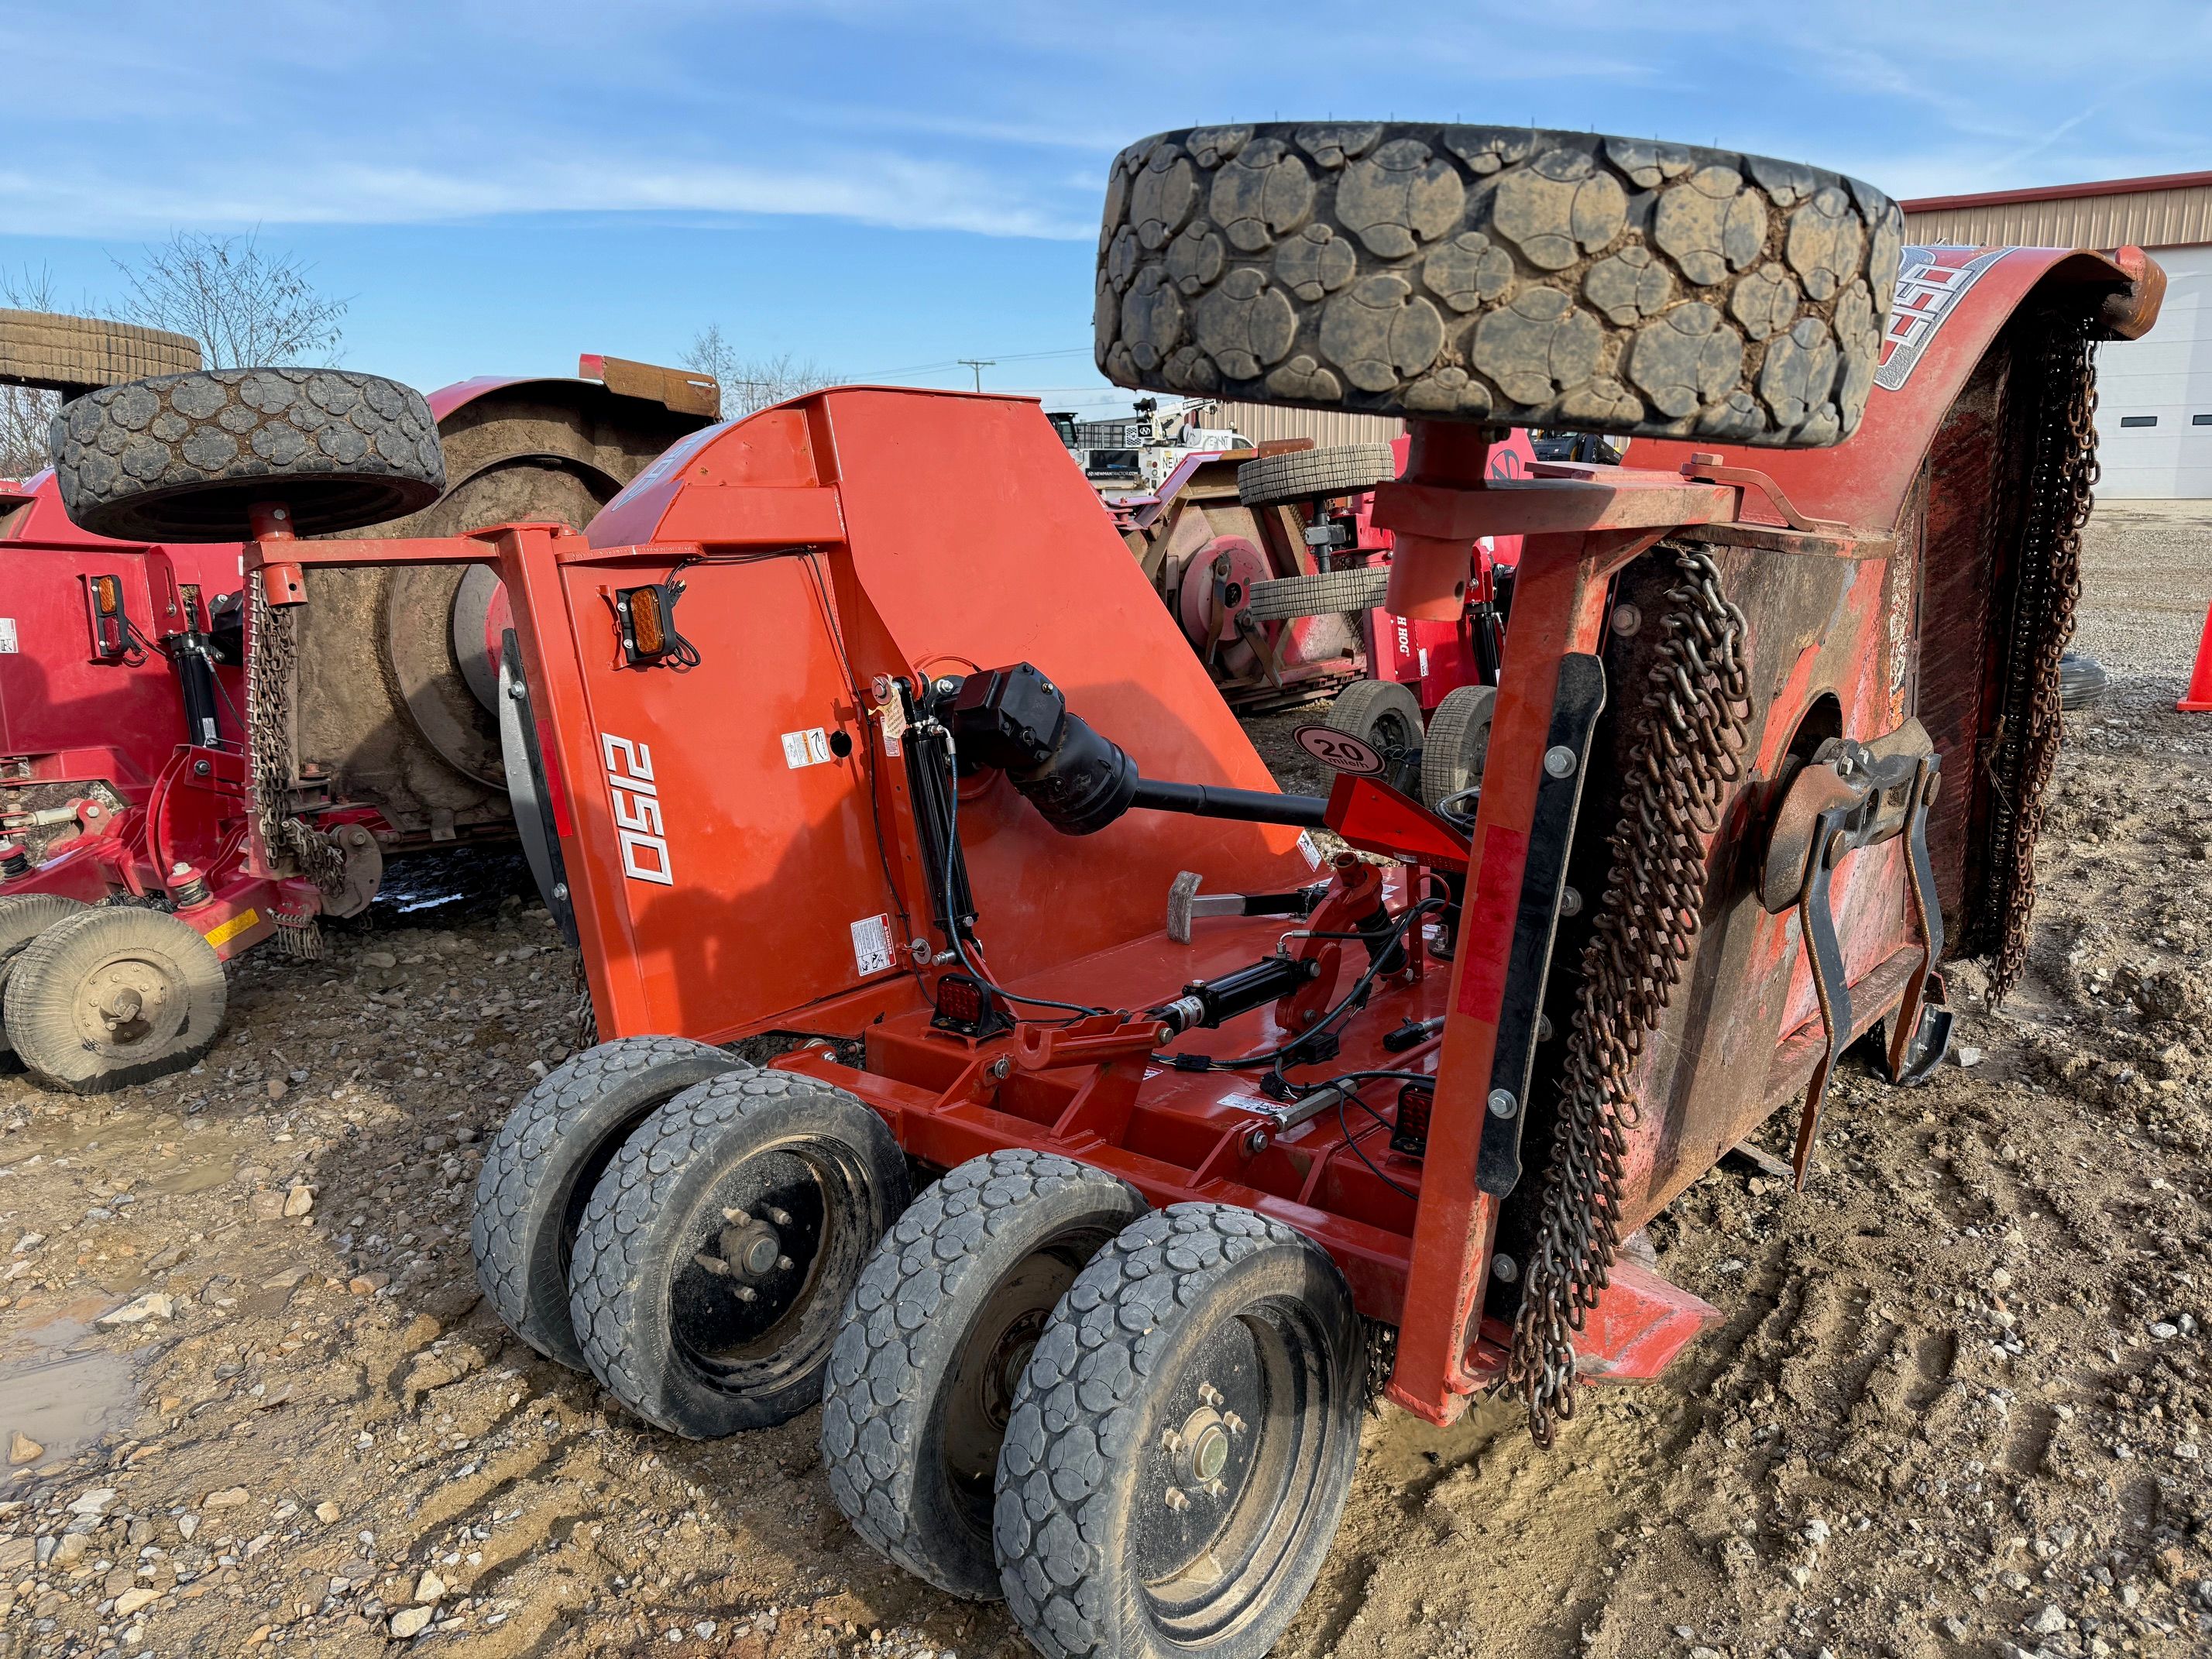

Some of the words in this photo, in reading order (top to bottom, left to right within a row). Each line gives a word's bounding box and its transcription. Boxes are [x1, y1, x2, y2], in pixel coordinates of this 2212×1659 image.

[1397, 627, 1410, 654] HOG
[1314, 738, 1365, 761] 20
[1328, 757, 1369, 769] mile/h
[601, 733, 673, 885] 2150
